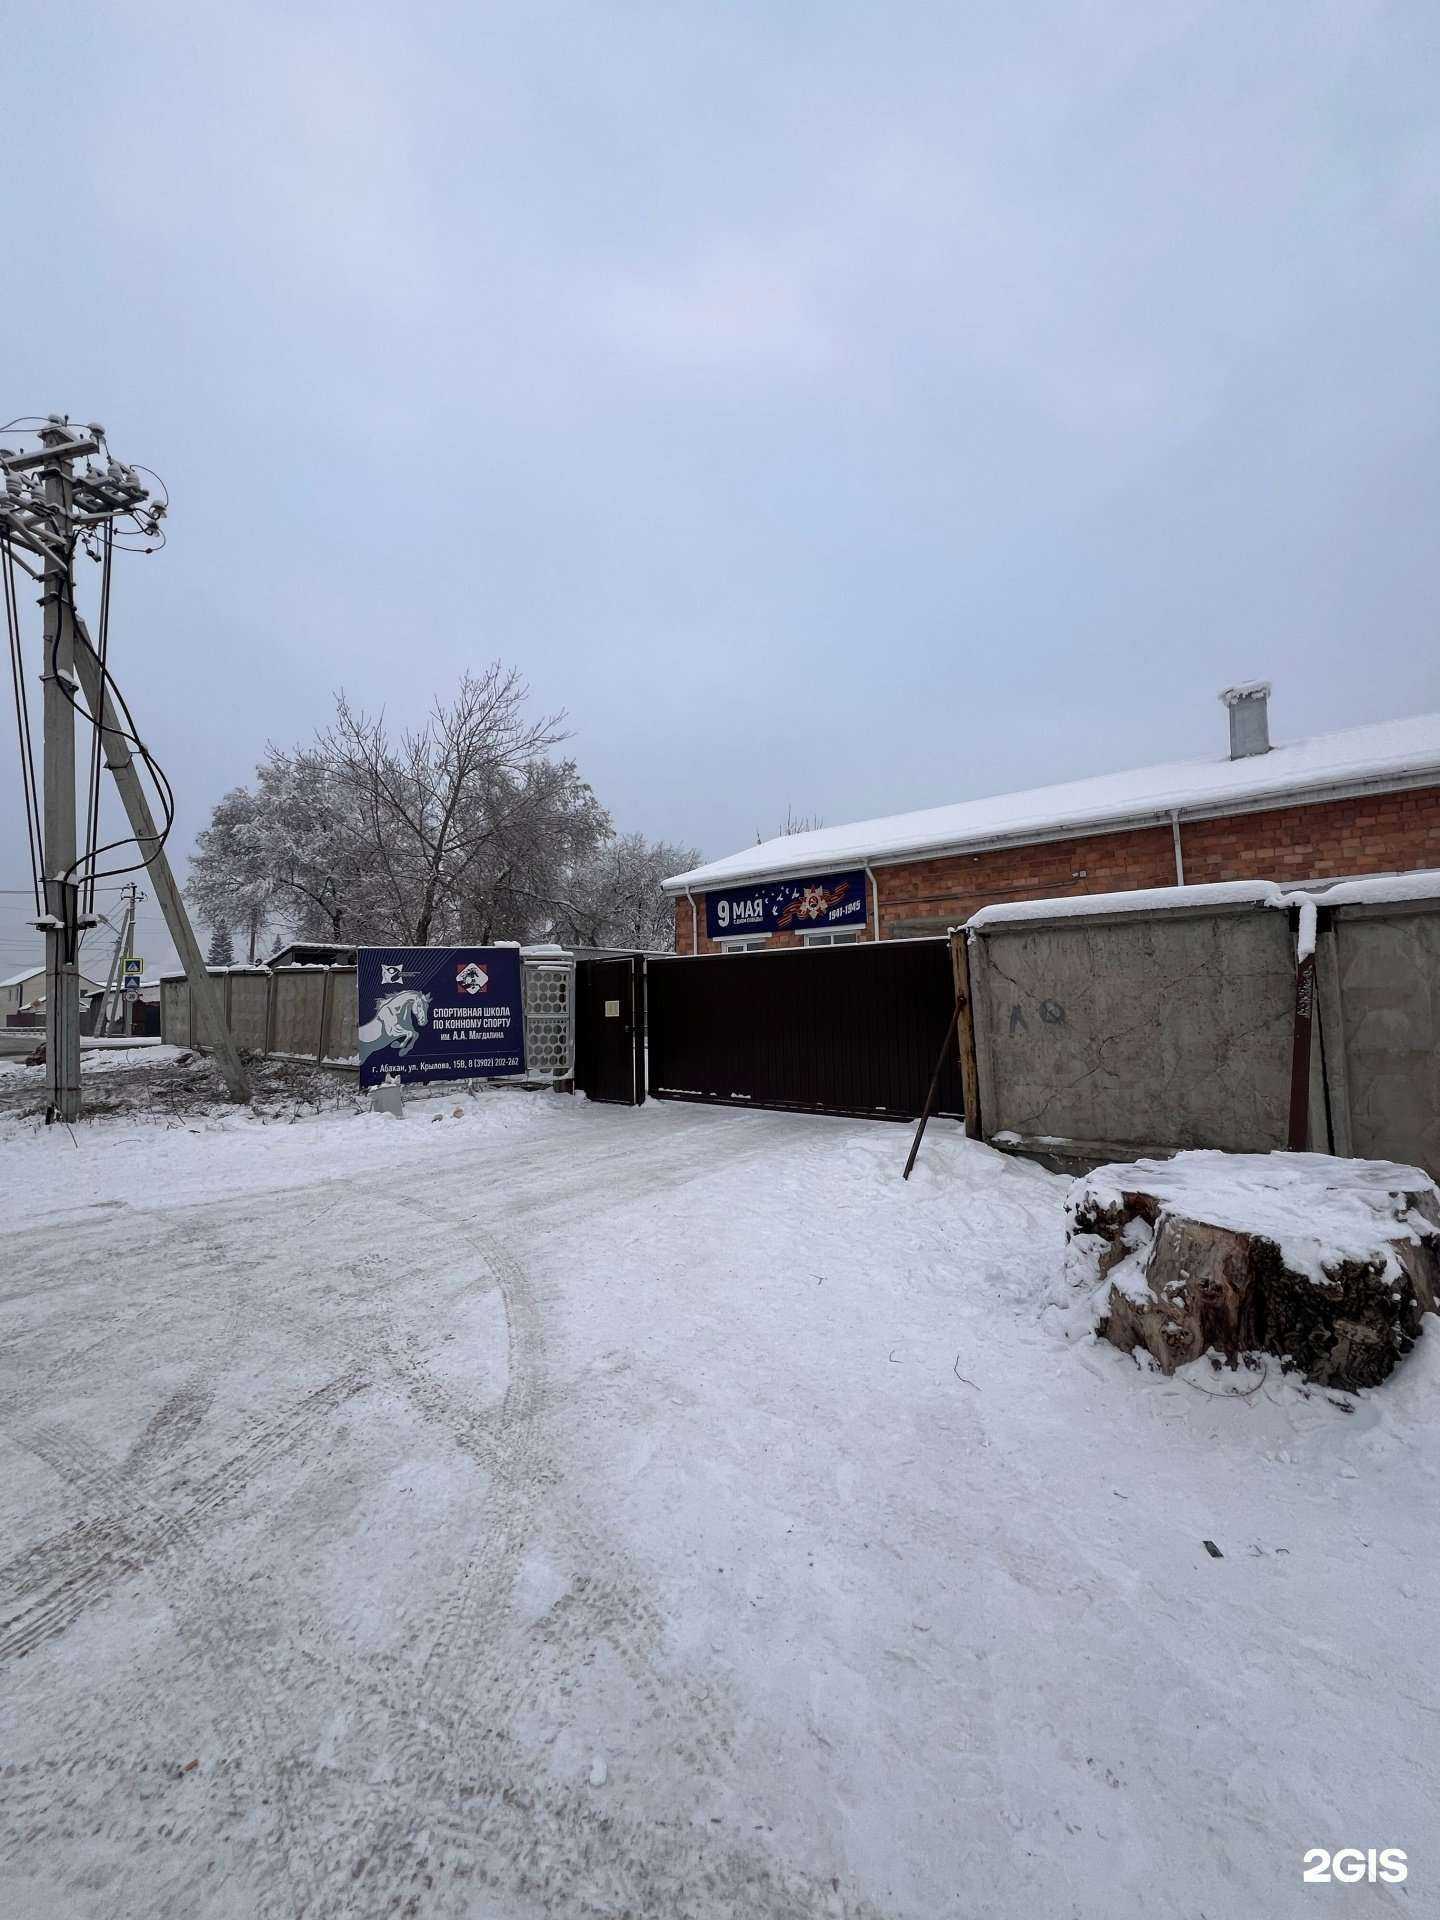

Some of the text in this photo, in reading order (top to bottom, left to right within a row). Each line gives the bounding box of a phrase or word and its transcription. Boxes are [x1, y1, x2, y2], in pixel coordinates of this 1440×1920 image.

[717, 898, 763, 928] 9 МАЯ
[828, 899, 861, 921] 1941-1945
[433, 1006, 511, 1018] СПОРТИВНАЯ ШКОЛА
[433, 1017, 511, 1029] ПО КОННОМУ СПОРТУ
[379, 1063, 407, 1073] Абакан,
